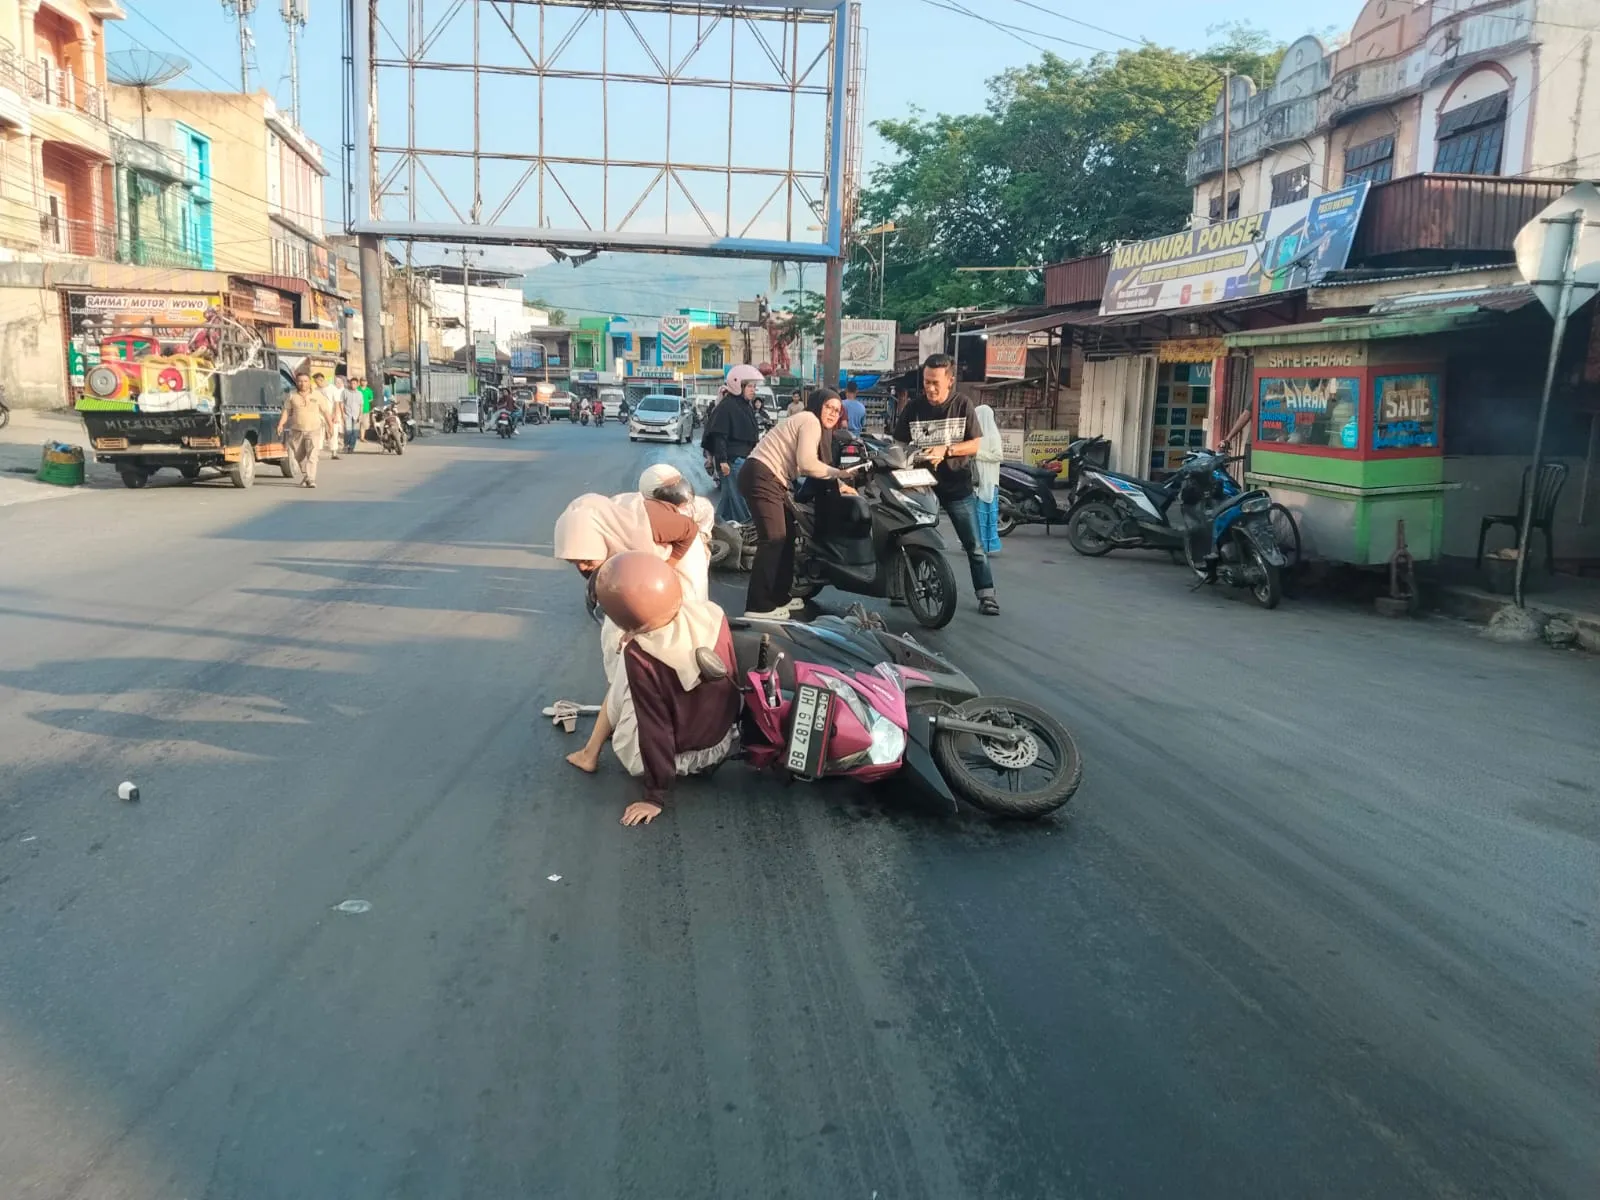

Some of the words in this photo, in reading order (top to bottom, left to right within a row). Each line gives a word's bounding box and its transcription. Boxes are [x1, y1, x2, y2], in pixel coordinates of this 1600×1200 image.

[1111, 232, 1193, 271] NAKAMURA
[87, 297, 129, 307] RAHMAT
[130, 298, 165, 308] MOTOR
[1269, 352, 1301, 368] SATE
[1303, 349, 1352, 367] PADANG
[1385, 389, 1431, 418] SATE
[802, 687, 815, 706] HU
[795, 711, 812, 745] 4819
[790, 750, 806, 768] BB
